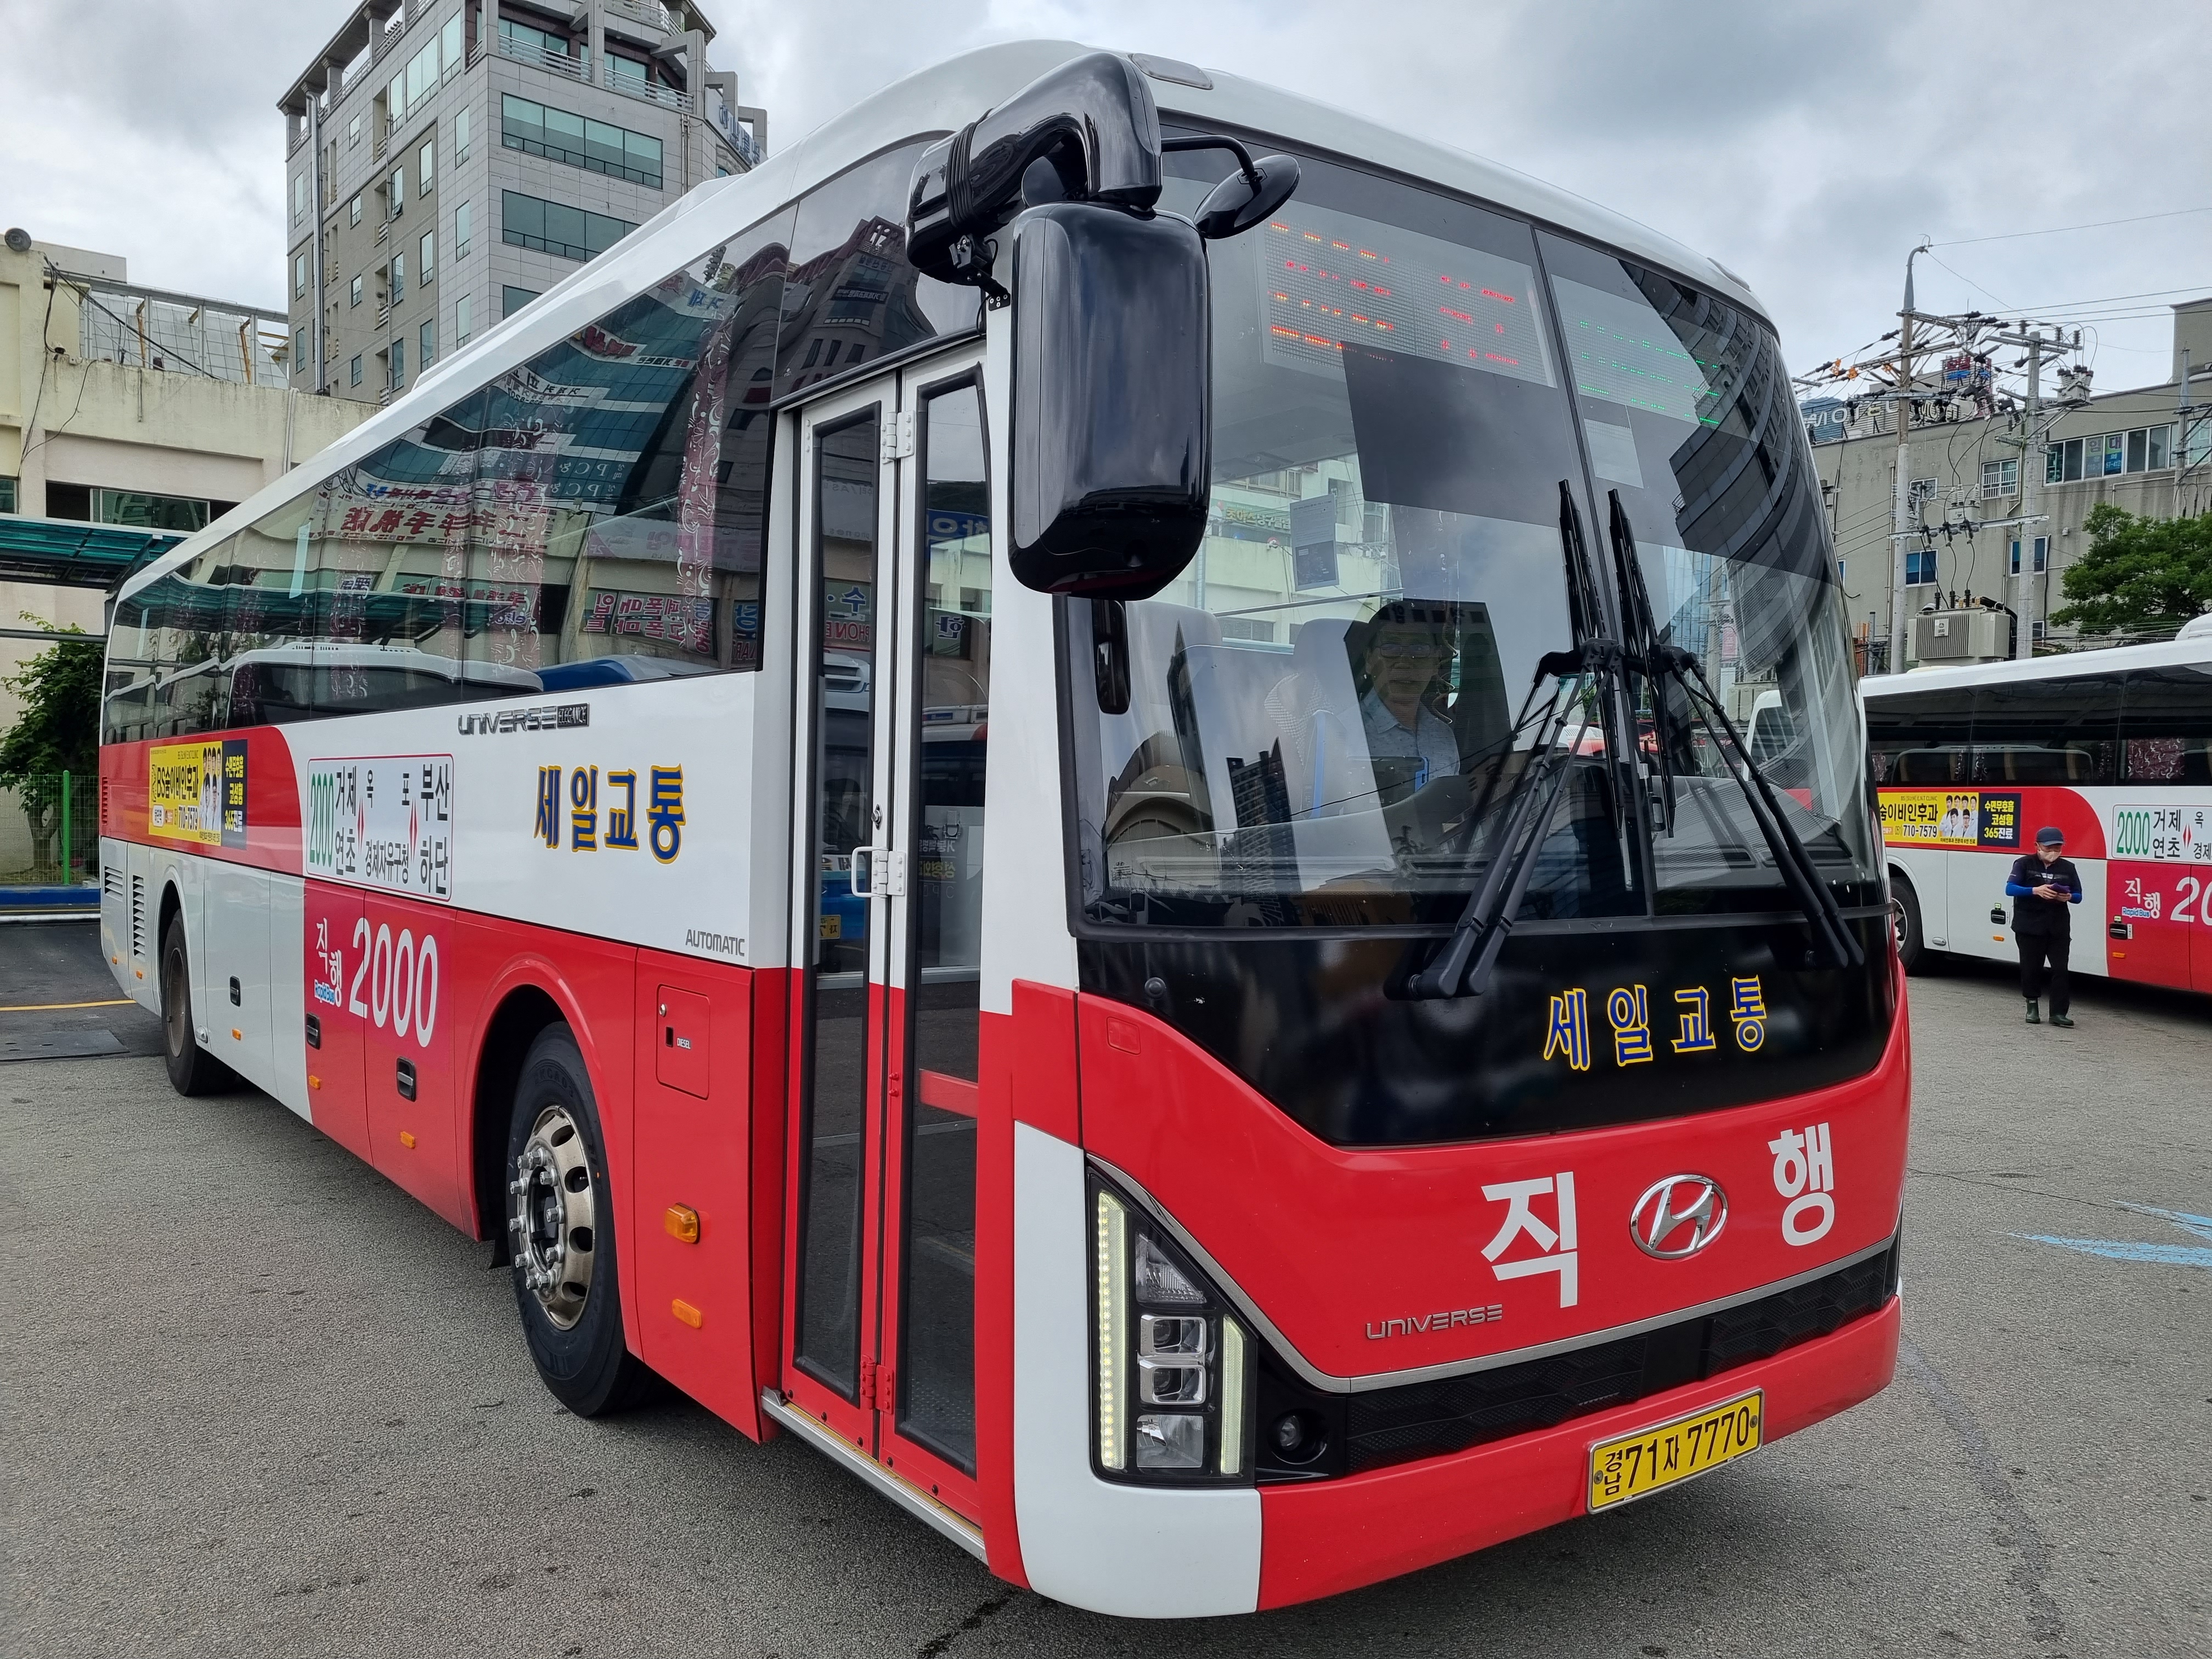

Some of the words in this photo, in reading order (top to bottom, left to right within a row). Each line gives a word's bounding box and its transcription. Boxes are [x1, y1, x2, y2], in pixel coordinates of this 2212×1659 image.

[458, 706, 557, 735] UNIVERSE
[335, 766, 357, 816] 거제
[420, 763, 450, 821] 부산
[1984, 800, 2014, 812] 수면무호흡
[178, 805, 198, 831] 710-7579
[309, 773, 334, 868] 2000
[533, 763, 686, 865] 세일교통
[1991, 813, 2013, 826] 코성형
[2153, 809, 2181, 832] 거제
[2194, 811, 2204, 829] 옥
[1903, 824, 1937, 838] 710-7579
[1984, 827, 2013, 839] 365진료
[2116, 811, 2150, 855] 2000
[335, 827, 356, 876] 연초
[365, 839, 409, 884] 경제자유구청
[420, 834, 449, 895] 하단
[2152, 837, 2181, 859] 연초
[2122, 907, 2139, 918] Rapid
[2139, 909, 2150, 918] Bus
[2124, 877, 2160, 919] 직행
[685, 928, 745, 956] AUTOMATIC
[316, 917, 342, 1007] 직행
[348, 917, 438, 1048] 2000
[1543, 974, 1768, 1071] 세일교통
[676, 1037, 691, 1049] DIESEL
[1366, 1304, 1503, 1341] UNIVERSE
[1604, 1449, 1623, 1496] 경남
